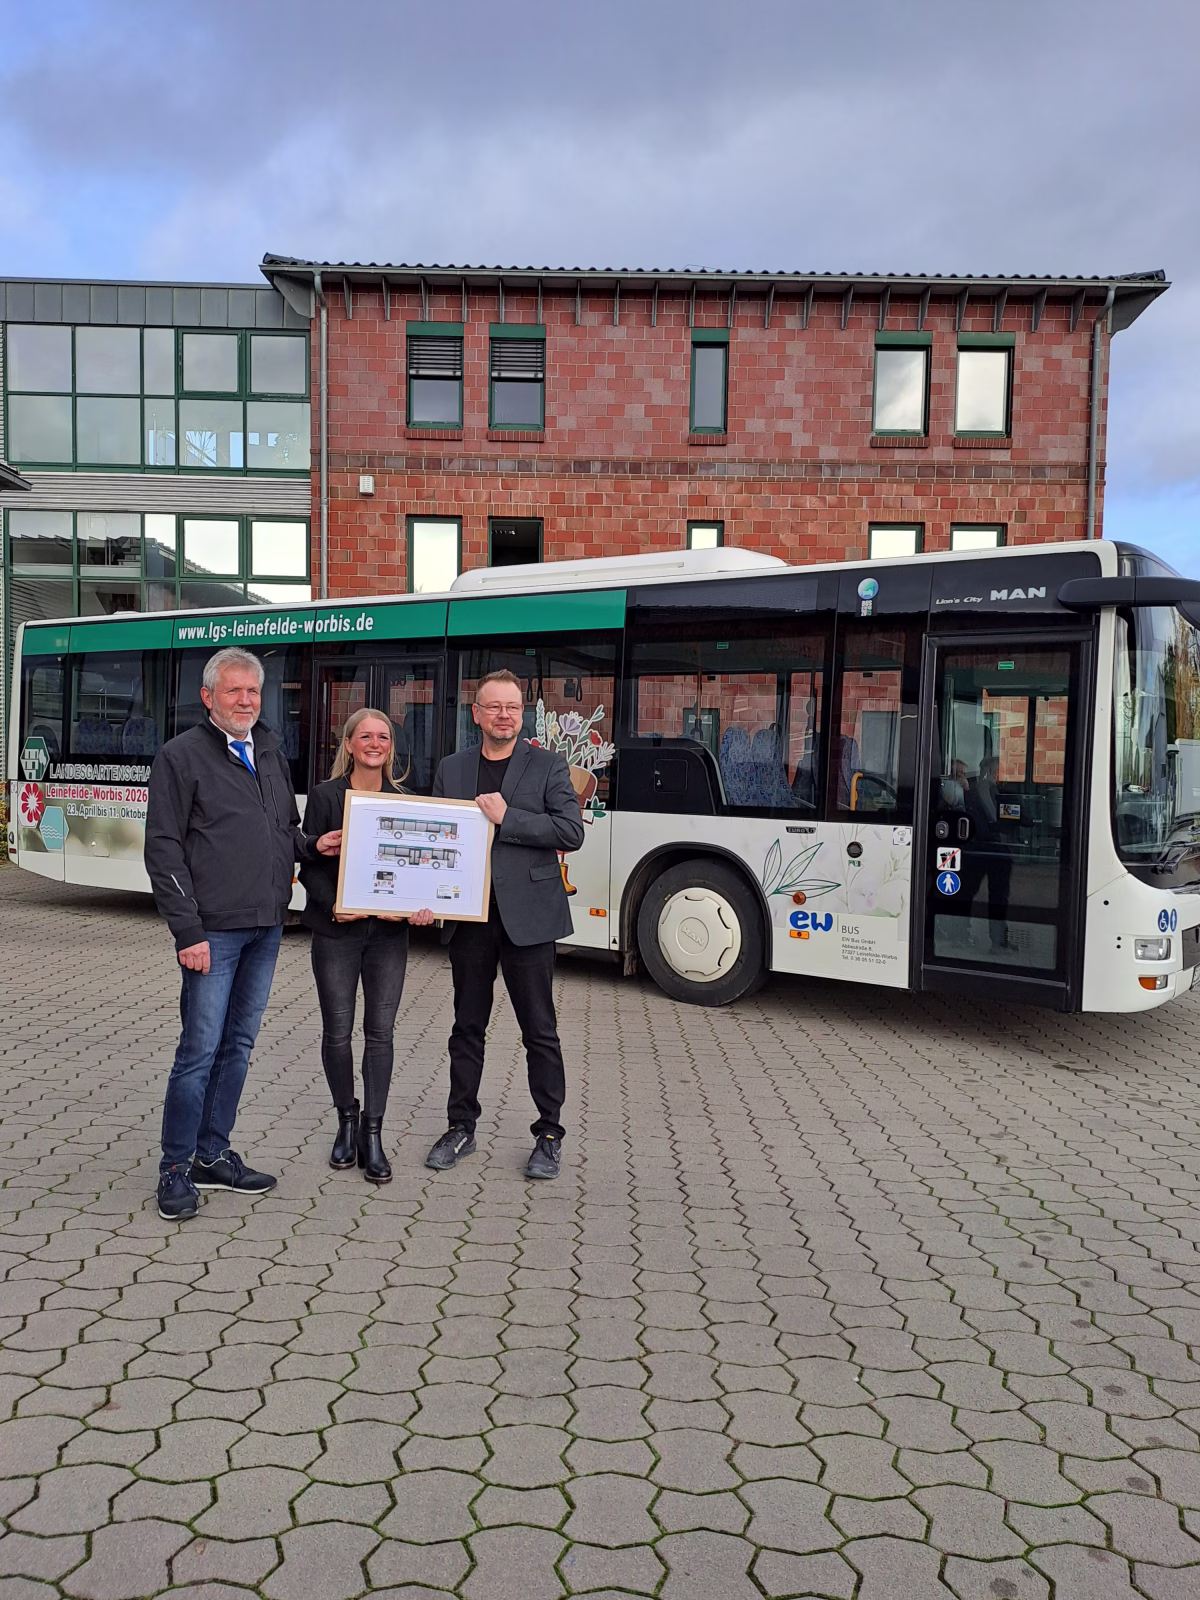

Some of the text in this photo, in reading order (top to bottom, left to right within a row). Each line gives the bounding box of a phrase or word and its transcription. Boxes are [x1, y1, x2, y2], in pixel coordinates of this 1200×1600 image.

[990, 586, 1046, 601] MAN
[178, 612, 374, 642] www.lgs-leinefelde-worbis.de
[50, 763, 151, 782] LANDESGARTENSCHA
[46, 784, 148, 803] Leinefelde-Worbis 2026
[67, 804, 146, 820] 23. April bis 11. Oktobe
[789, 910, 833, 932] ew
[841, 925, 860, 934] BUS
